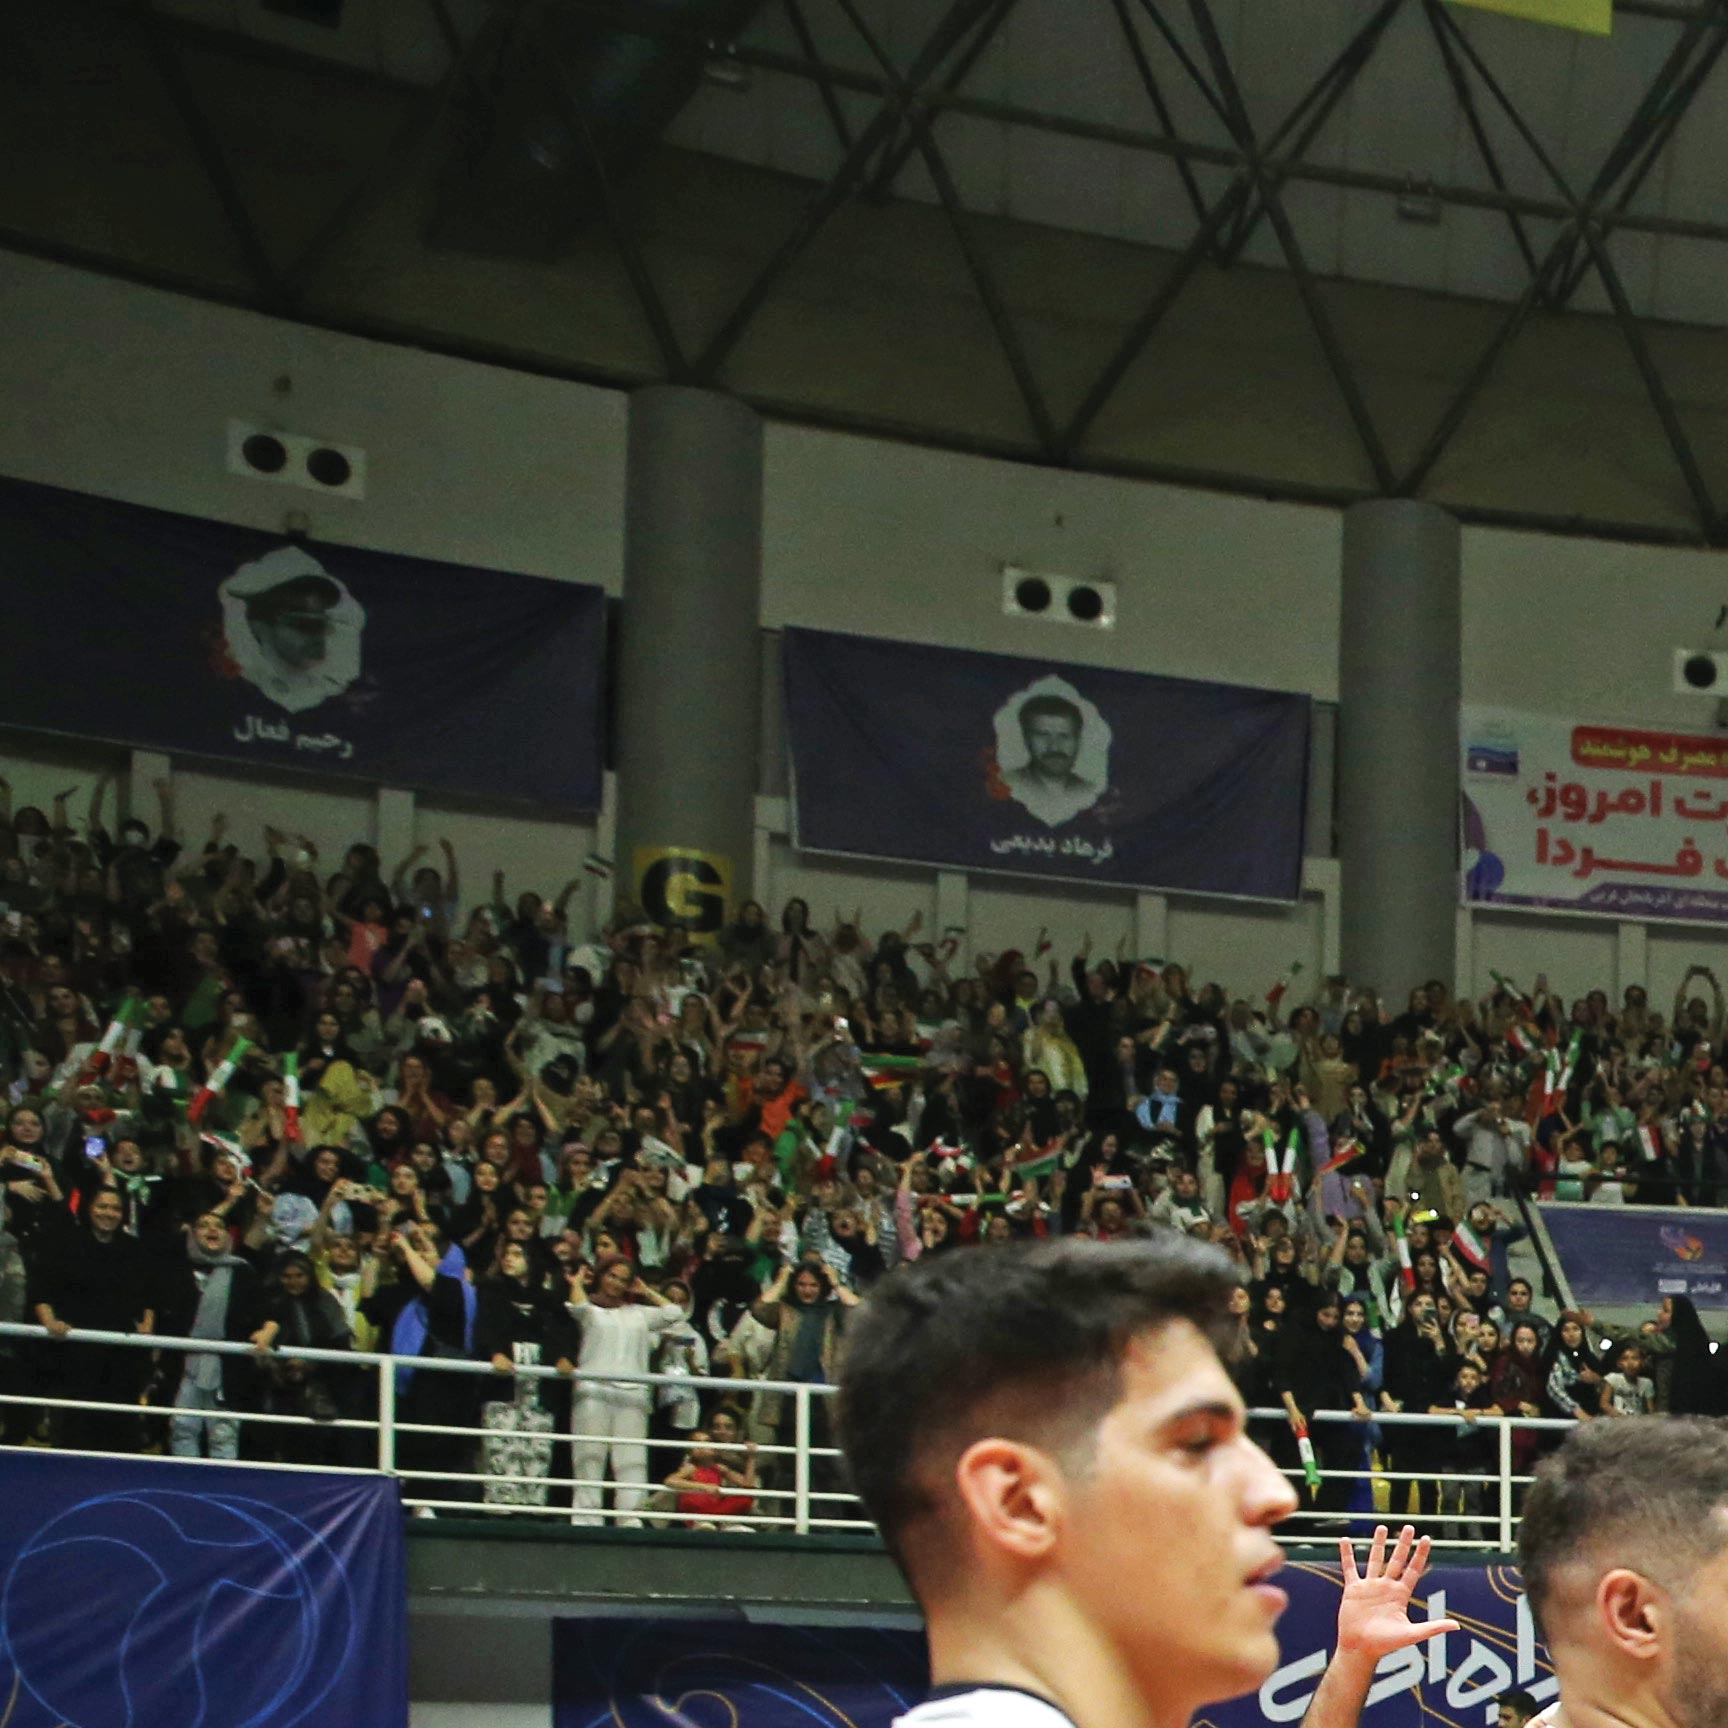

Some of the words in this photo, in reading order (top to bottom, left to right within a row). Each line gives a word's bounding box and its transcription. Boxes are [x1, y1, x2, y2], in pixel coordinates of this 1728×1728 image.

[234, 715, 290, 742] فعال
[1536, 827, 1703, 877] فردا
[640, 856, 725, 932] G
